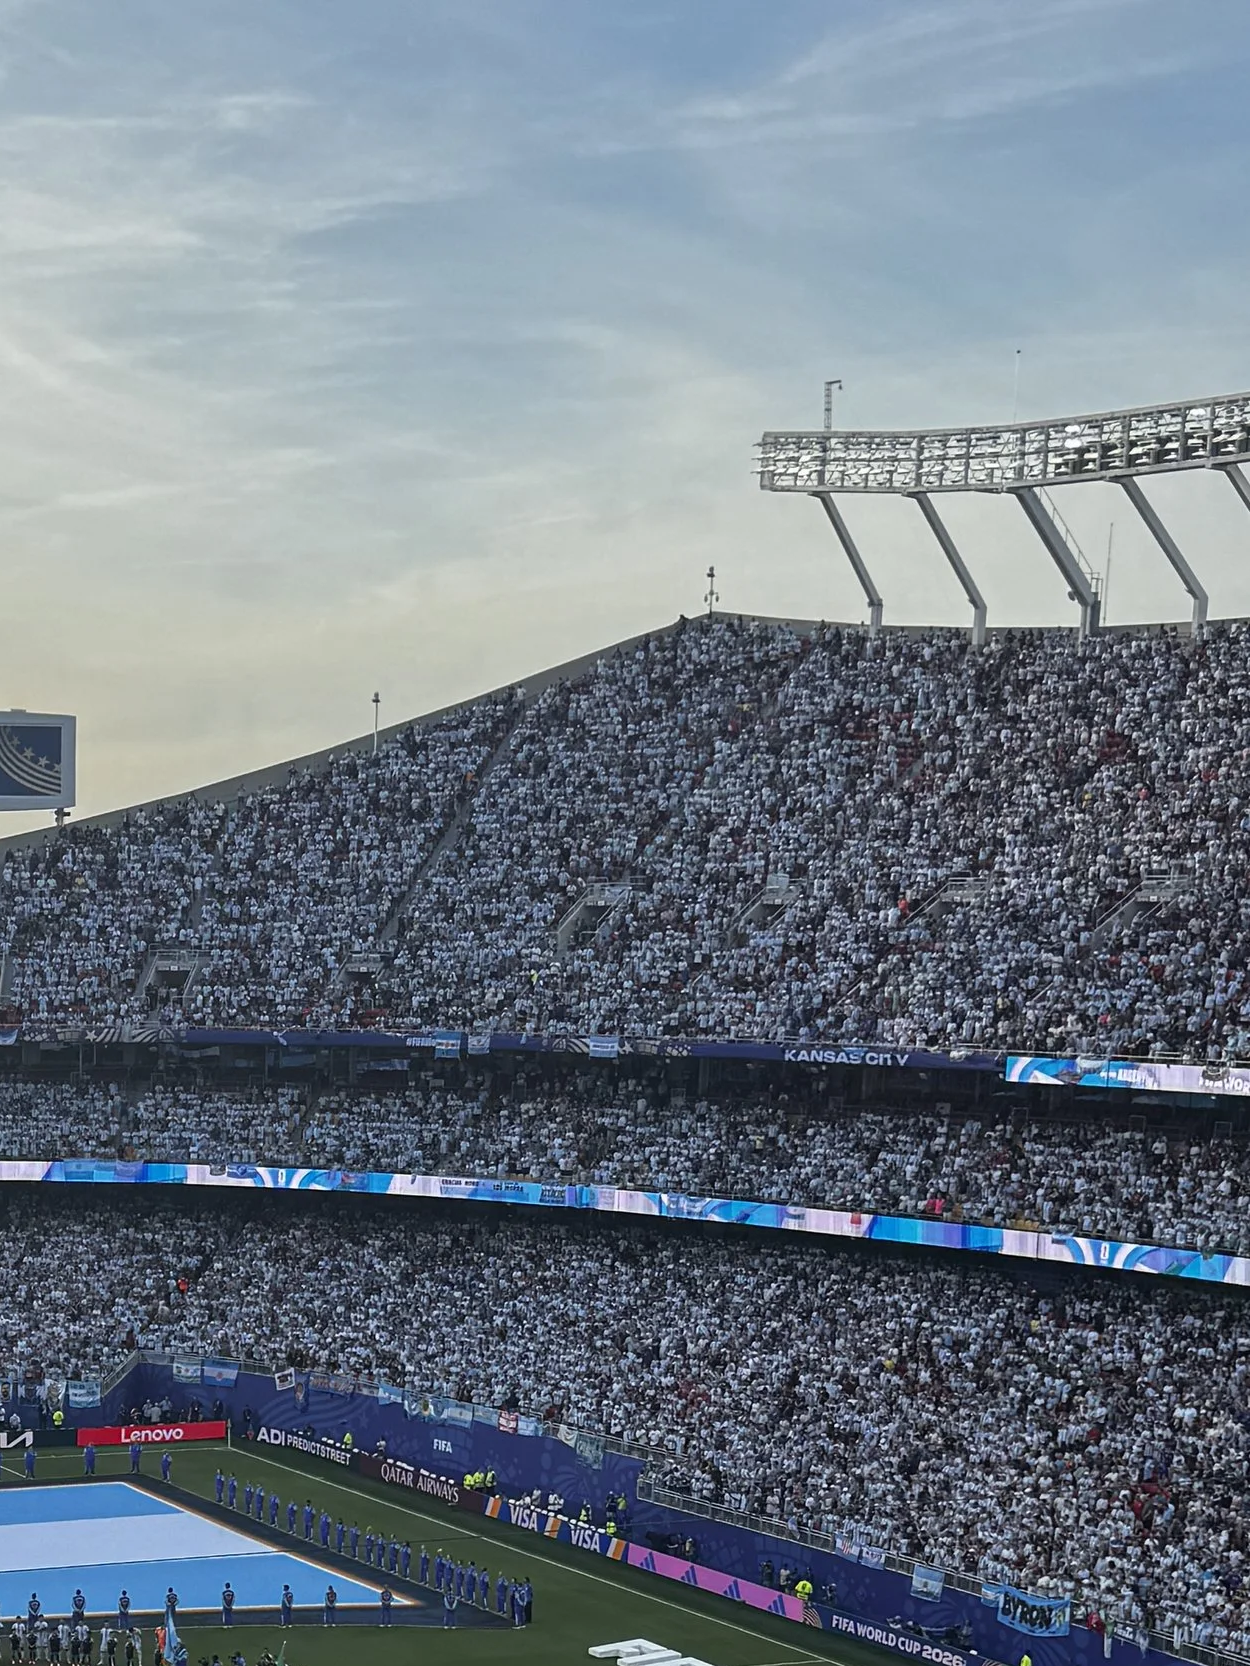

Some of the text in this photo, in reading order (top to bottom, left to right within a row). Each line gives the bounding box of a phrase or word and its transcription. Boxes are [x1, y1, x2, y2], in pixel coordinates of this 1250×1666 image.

[784, 1049, 910, 1067] KANSAS CITY
[121, 1427, 184, 1443] Lenovo
[256, 1426, 351, 1466] ADI PREDICTSTREET
[433, 1438, 453, 1454] FIFA
[380, 1463, 460, 1503] QATAR AIRWAYS
[509, 1503, 539, 1532] VISA
[569, 1523, 601, 1553] VISA
[832, 1614, 856, 1635] FIFA
[856, 1622, 897, 1647] WORLD
[897, 1636, 922, 1654] CUP
